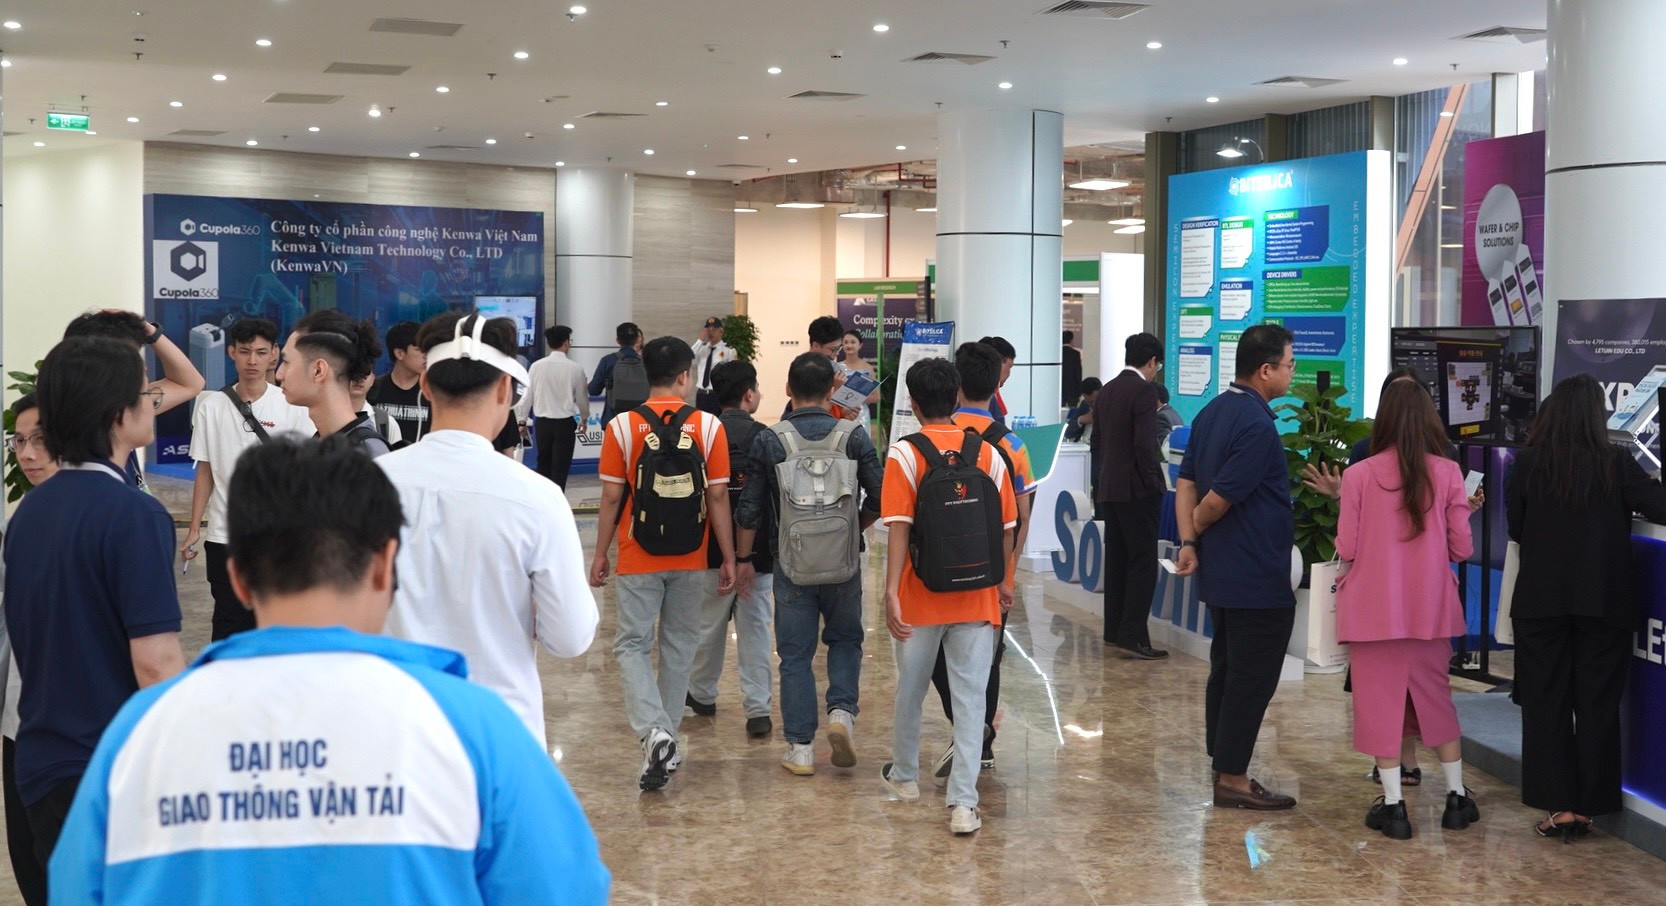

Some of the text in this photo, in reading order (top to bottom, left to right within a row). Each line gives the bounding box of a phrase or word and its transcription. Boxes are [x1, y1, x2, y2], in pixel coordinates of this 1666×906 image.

[200, 223, 261, 236] Cupola360
[270, 219, 538, 244] Công ty cổ phần công nghệ Kenwa Việt Nam
[1479, 222, 1520, 234] WAFER & CHIP
[1483, 236, 1514, 248] SOLUTIONS
[271, 240, 317, 253] Kenwa
[321, 241, 374, 255] Vietnam
[377, 244, 446, 260] Technology
[476, 247, 503, 259] LTD
[270, 259, 348, 276] (KenwaVN)
[1266, 271, 1280, 279] DEVICE
[159, 288, 219, 299] Cupola360
[853, 314, 903, 327] Compexity
[229, 738, 328, 779] ĐẠI HỌC
[158, 772, 405, 827] GIAO THÔNG VẬN TẢI
